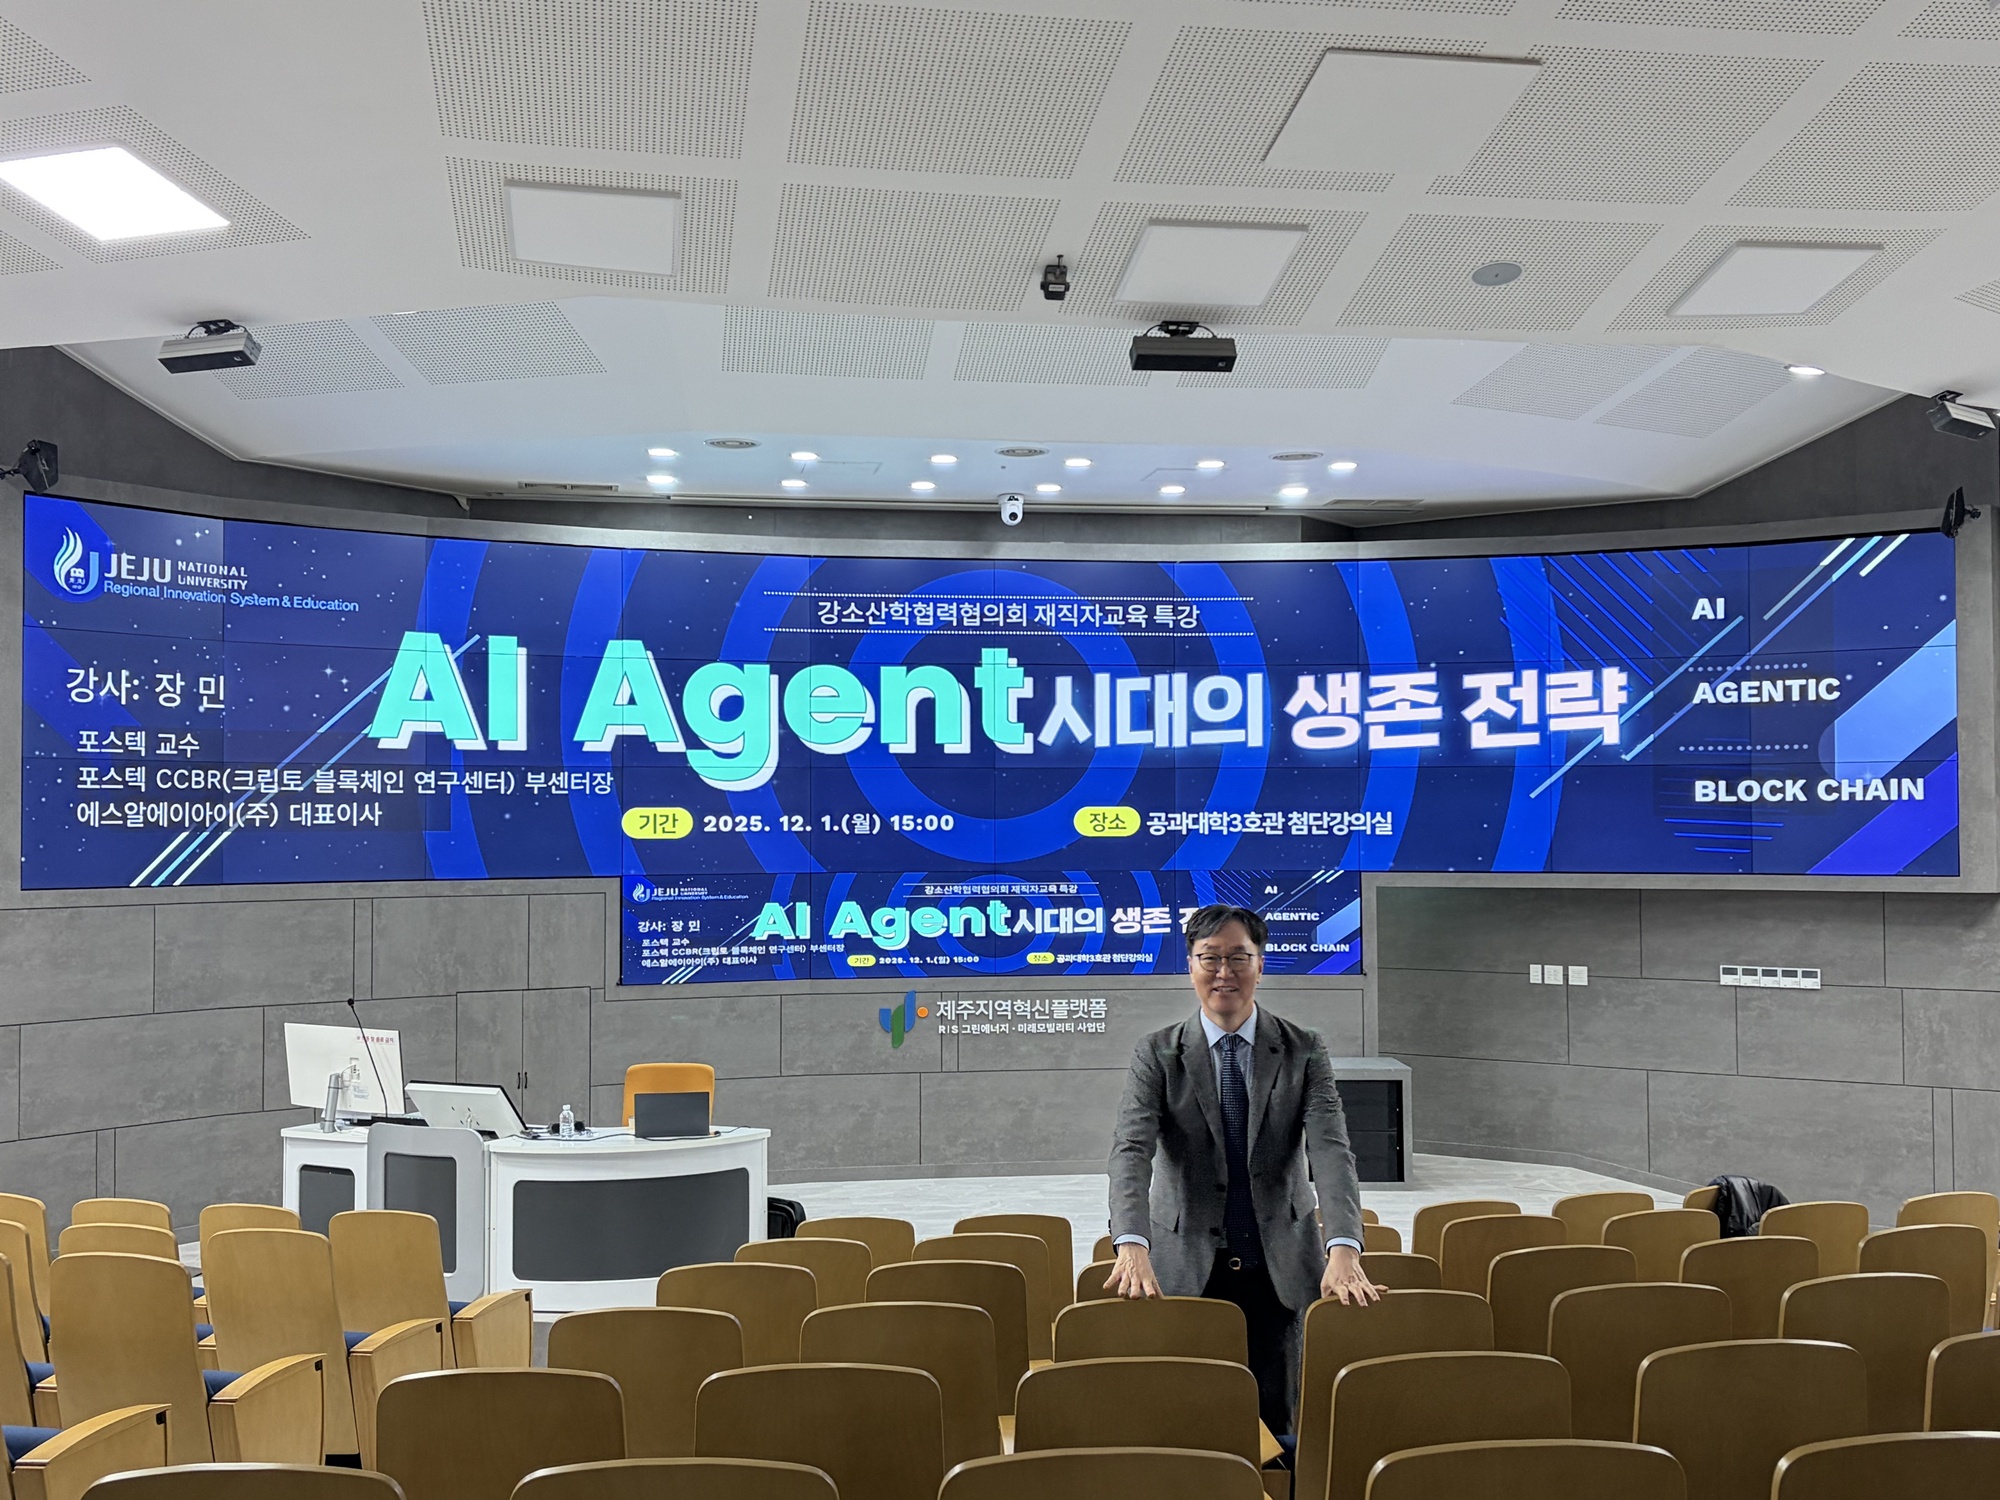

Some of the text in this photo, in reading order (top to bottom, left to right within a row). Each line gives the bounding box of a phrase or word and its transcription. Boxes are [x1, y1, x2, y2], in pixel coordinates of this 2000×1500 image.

[104, 552, 172, 583] JEJU
[177, 560, 248, 577] NATIONAL
[178, 574, 248, 591] UNIVERSITY
[104, 580, 359, 611] Regional Innovation System & Education
[817, 600, 1201, 629] 강소산학협력협의회 재직자교육 특강
[1691, 598, 1726, 620] AI
[66, 666, 226, 709] 강사: 장 민
[1692, 678, 1841, 704] AGENTIC
[367, 630, 1629, 791] AI Agent 시대의 생존 전략
[77, 731, 200, 758] 포스텍 교수
[77, 766, 614, 795] 포스텍 CCBR(크립토 블록체인 연구센터) 부센터장
[1694, 778, 1925, 802] BLOCK CHAIN
[77, 801, 383, 828] 에스알에이아이(주) 대표이사
[639, 813, 678, 834] 기간
[703, 813, 955, 835] 2025. 12. 1.(월) 15:00
[1089, 812, 1128, 832] 장소
[1146, 811, 1394, 836] 공과대학3호관 첨단강의실
[652, 888, 679, 897] JEJU
[1264, 886, 1278, 894] AI
[638, 920, 701, 932] 강사: 장 민
[751, 901, 811, 940] AI
[828, 900, 1012, 950] Agent
[1013, 907, 1103, 934] 시대의
[1110, 907, 1171, 934] 생존
[1265, 912, 1320, 921] AGENTIC
[672, 938, 690, 947] 교수
[1265, 943, 1350, 952] BLOCK CHAIN
[854, 957, 869, 965] 기간
[879, 957, 906, 965] 2025.
[953, 956, 979, 964] 15:00
[1033, 954, 1048, 962] 장소
[936, 998, 1107, 1020] 제주지역혁신플랫폼
[961, 1023, 1009, 1034] 그린에너지
[1018, 1023, 1075, 1034] 미래모빌리티
[1077, 1022, 1106, 1033] 사업단
